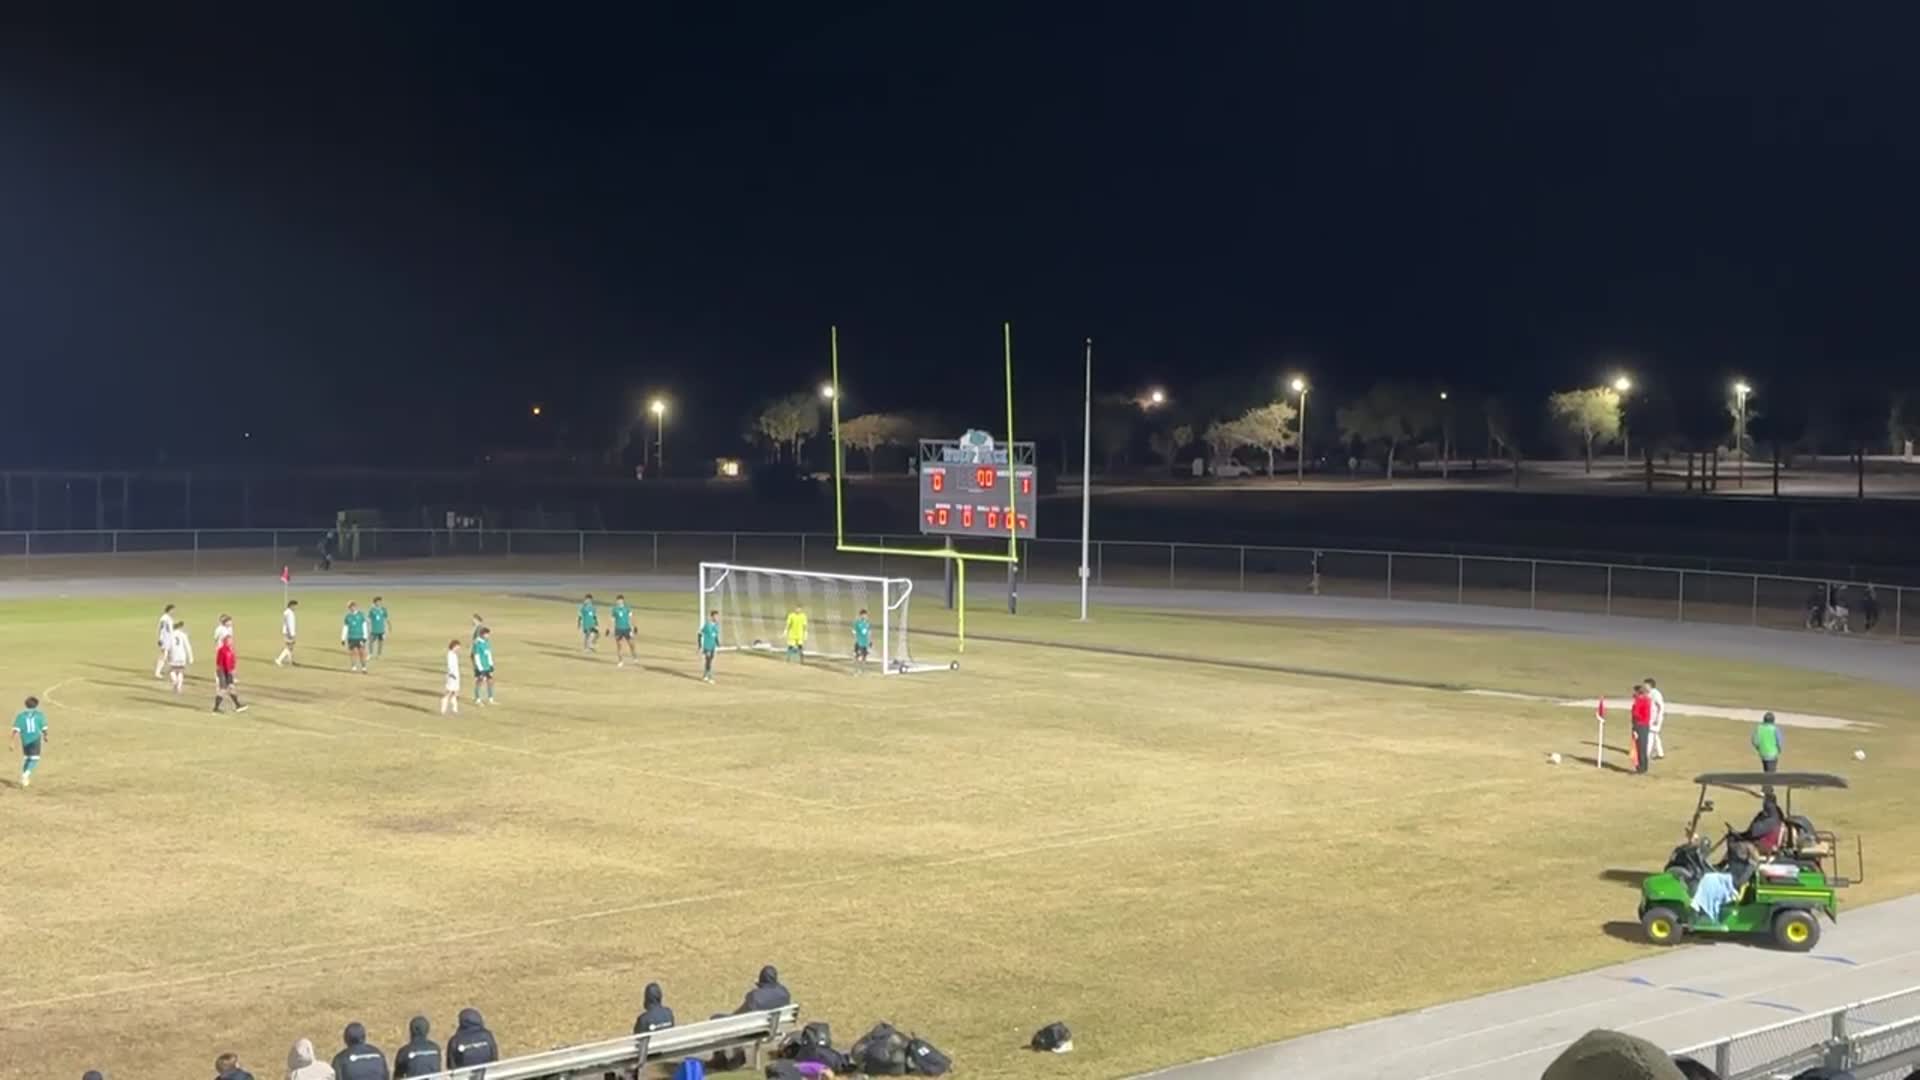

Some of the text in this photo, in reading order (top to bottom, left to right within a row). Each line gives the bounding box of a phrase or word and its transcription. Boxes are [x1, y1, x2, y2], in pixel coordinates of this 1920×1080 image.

[933, 474, 941, 491] 0
[938, 509, 947, 525] 0
[963, 511, 971, 527] 0
[988, 512, 996, 529] 0
[26, 717, 36, 734] 11
